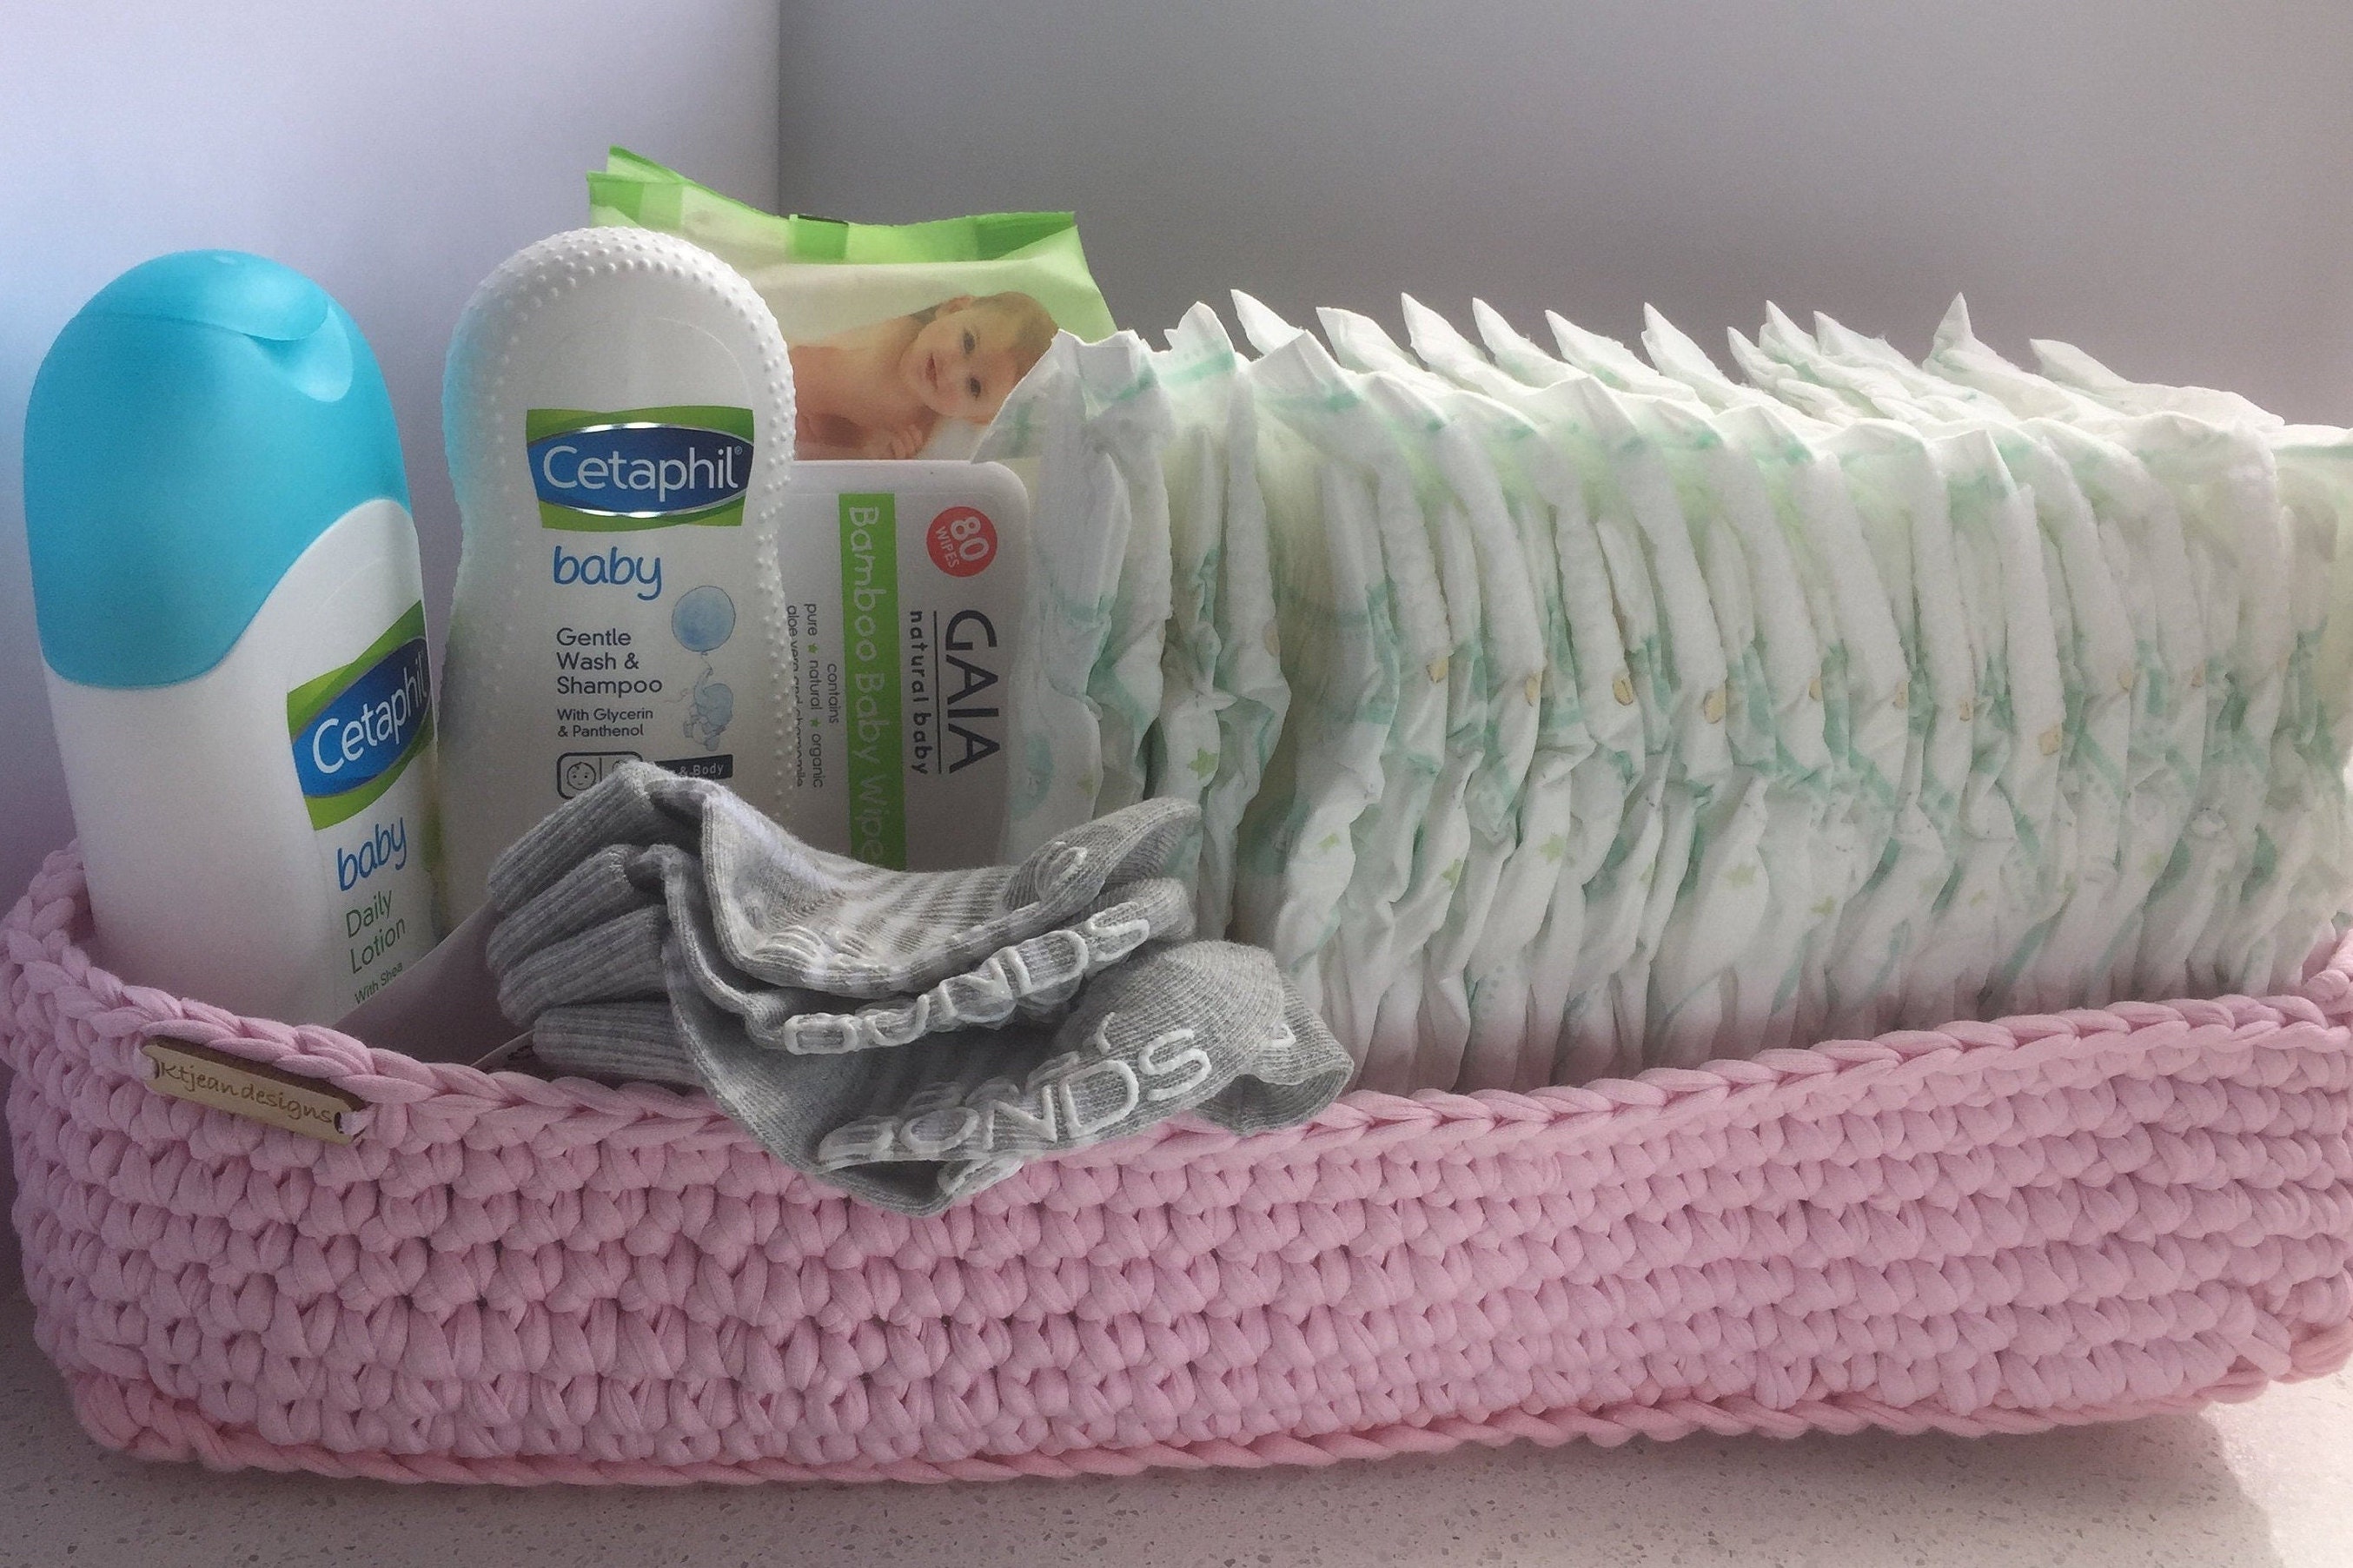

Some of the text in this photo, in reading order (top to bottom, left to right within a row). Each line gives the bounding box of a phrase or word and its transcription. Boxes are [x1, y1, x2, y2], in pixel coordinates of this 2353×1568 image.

[936, 526, 959, 568] WIPES
[951, 516, 989, 561] 80
[553, 546, 662, 600] baby
[849, 506, 886, 662] Bamboo
[556, 627, 632, 645] Gentle
[787, 605, 800, 637] aloe
[556, 652, 640, 671] Wash &
[557, 676, 663, 698] Shampoo
[804, 603, 825, 788] pure natural organic
[827, 663, 840, 724] contains
[910, 611, 933, 775] natural baby
[945, 610, 1000, 774] GAIA
[313, 652, 428, 774] Cetaphil
[557, 707, 654, 724] With Glycerin
[557, 724, 645, 738] & Panthenol
[852, 673, 891, 764] Baby
[693, 763, 725, 777] Body
[337, 817, 407, 891] baby
[346, 890, 393, 938] Daily
[349, 918, 406, 974] Lotion
[355, 962, 404, 1004] With Shea
